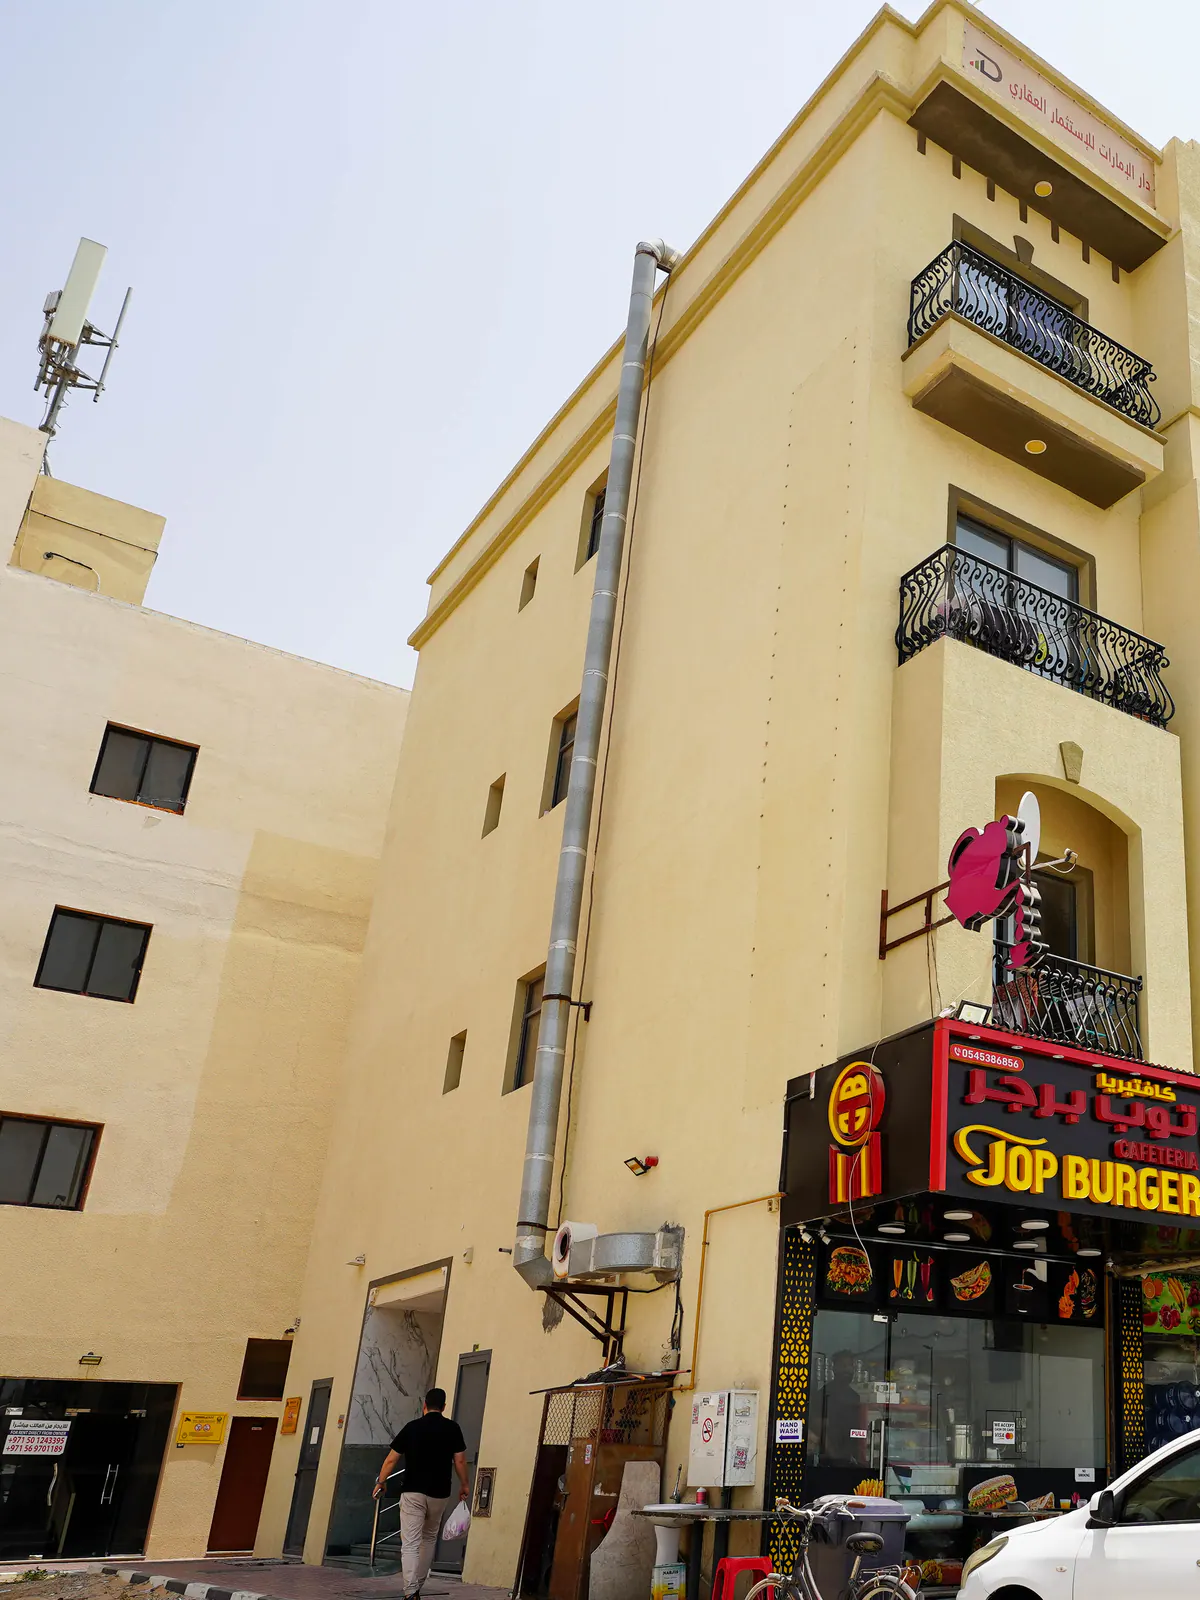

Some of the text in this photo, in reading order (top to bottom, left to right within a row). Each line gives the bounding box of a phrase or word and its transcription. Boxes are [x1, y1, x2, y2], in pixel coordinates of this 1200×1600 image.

[1009, 81, 1047, 115] العقاري
[1138, 173, 1151, 190] دار
[962, 1048, 1019, 1069] 0545386856
[1096, 1072, 1176, 1102] كافتيريا
[964, 1068, 1198, 1139] توب برجر
[1114, 1138, 1200, 1171] CAFETERIA
[8, 1436, 25, 1444] +971
